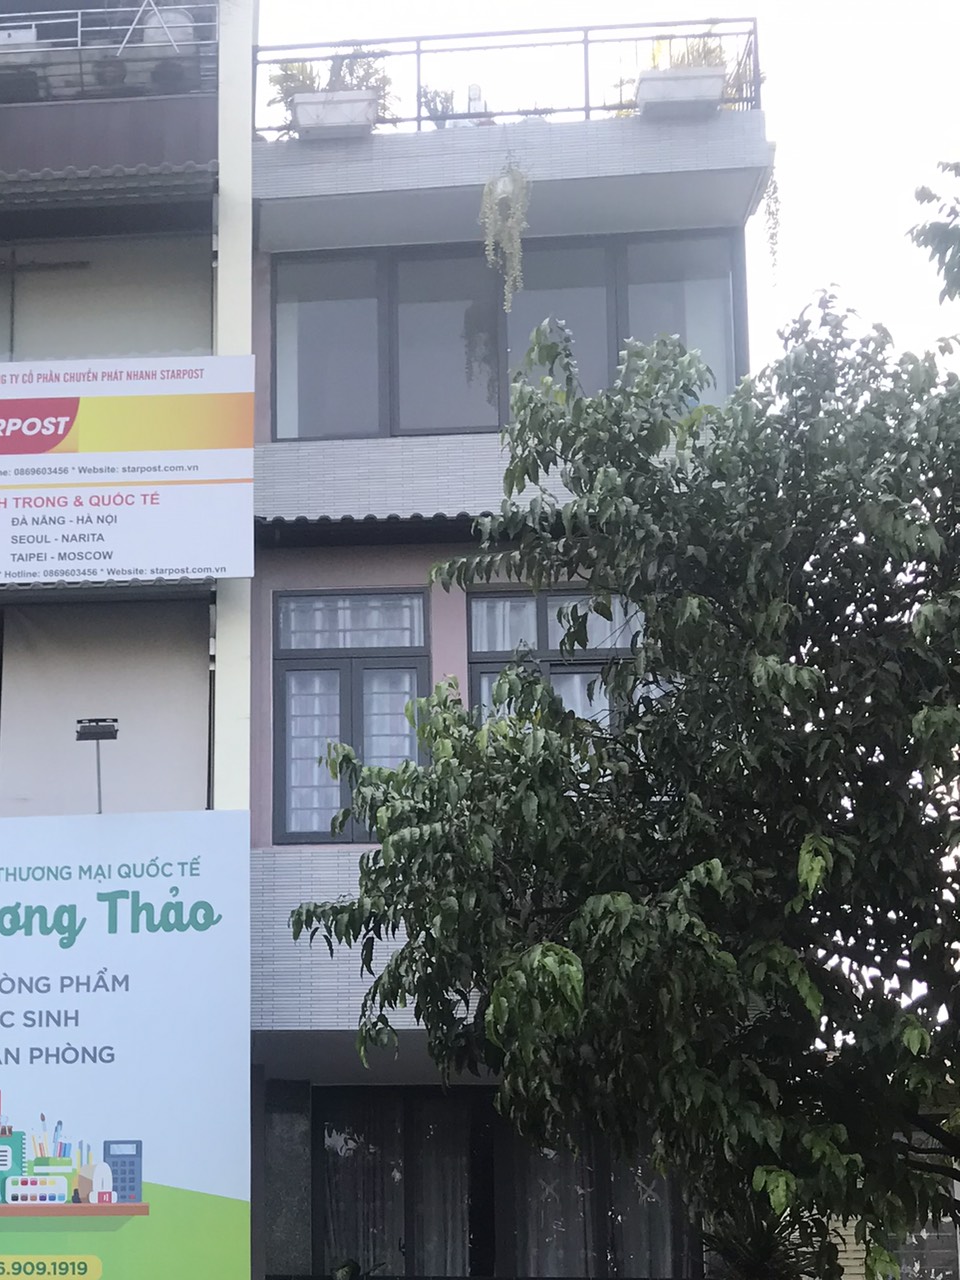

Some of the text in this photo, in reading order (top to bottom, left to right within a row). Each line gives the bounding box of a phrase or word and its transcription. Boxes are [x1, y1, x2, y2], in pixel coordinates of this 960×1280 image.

[10, 374, 19, 384] TY
[101, 369, 123, 382] PHÁT
[126, 370, 157, 382] NHANH
[160, 368, 205, 380] STARPOST
[14, 466, 69, 476] 0869603456
[78, 465, 119, 474] Website:
[122, 463, 199, 475] starpost.com.vn
[13, 496, 68, 509] TRONG
[73, 495, 84, 507] &
[89, 491, 135, 507] QUỐC
[11, 514, 28, 527] ĐÀ
[76, 512, 93, 525] HÀ
[96, 513, 118, 527] NỘI
[11, 533, 105, 544] SEOUL NARITA
[10, 551, 113, 563] TAIPEI MOSCOW
[4, 570, 40, 579] Hotline:
[43, 568, 98, 578] 0869603456
[107, 567, 147, 576] Website:
[150, 565, 227, 576] starpost.com.vn
[81, 863, 112, 883] MẠI
[117, 857, 173, 880] QUỐC
[177, 855, 201, 877] TẾ
[96, 886, 222, 934] Thảo
[59, 967, 130, 994] PHẨM
[22, 1009, 80, 1028] SINH
[28, 1042, 116, 1064] PHÒNG
